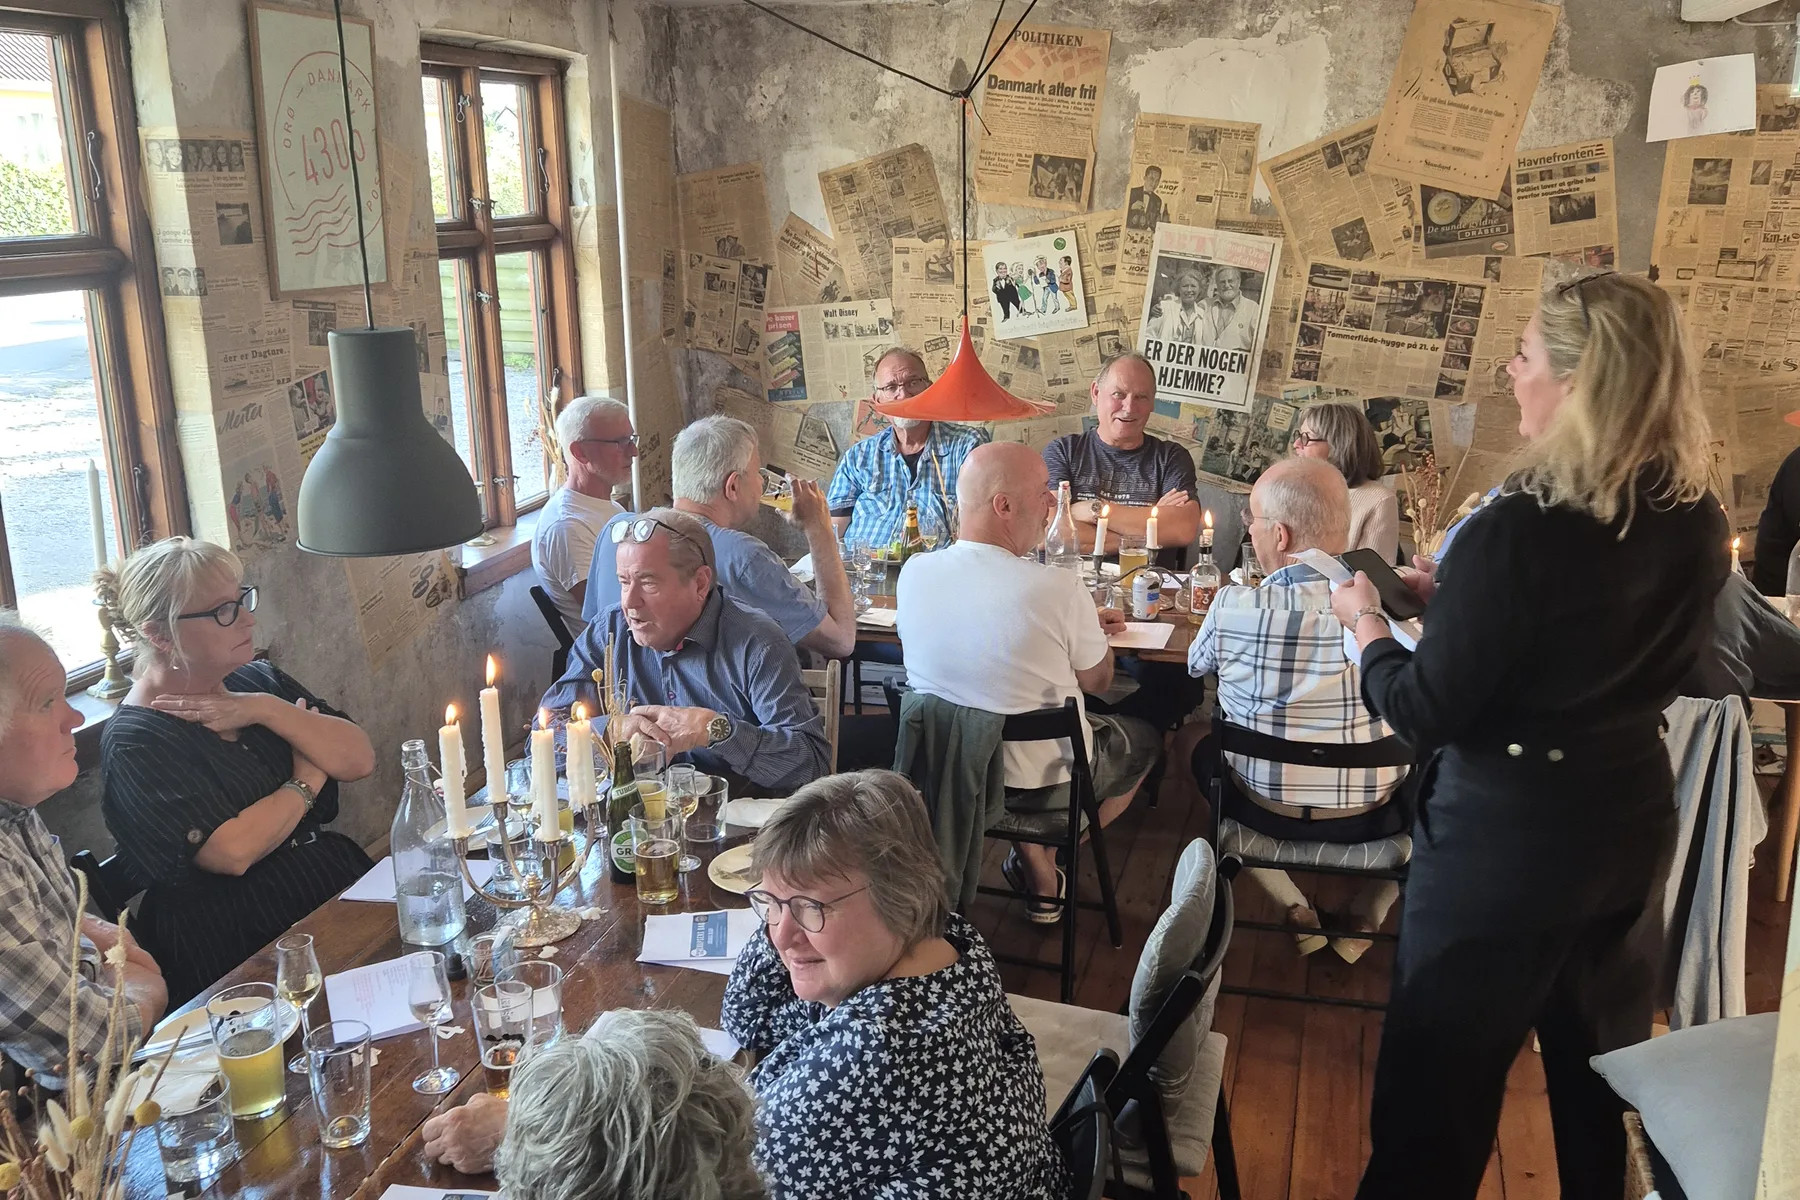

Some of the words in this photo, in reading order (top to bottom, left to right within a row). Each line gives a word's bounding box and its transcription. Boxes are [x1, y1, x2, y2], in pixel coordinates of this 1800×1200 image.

[1013, 30, 1084, 47] POLITIKEN
[987, 74, 1046, 95] Danmark
[1048, 81, 1077, 98] atter
[1079, 83, 1097, 100] frit
[1517, 148, 1594, 168] Havnefronten
[1516, 183, 1540, 193] Politiet
[1566, 179, 1584, 187] gribe
[1427, 225, 1439, 234] De
[1440, 222, 1466, 233] sunde
[1464, 226, 1501, 238] DRÅBER
[1762, 232, 1791, 243] Kill-it
[823, 309, 837, 318] Walt
[838, 309, 858, 318] Disney
[767, 323, 792, 332] prisen
[1327, 330, 1405, 348] Tømmerflåde-hygge
[1406, 341, 1417, 349] på
[1430, 343, 1439, 352] år
[223, 352, 238, 363] der
[240, 352, 250, 360] er
[1144, 338, 1163, 361] ER
[1166, 342, 1195, 366] DER
[1198, 347, 1248, 374] NOGEN
[1157, 366, 1225, 395] HJEMME?
[616, 847, 635, 856] GR
